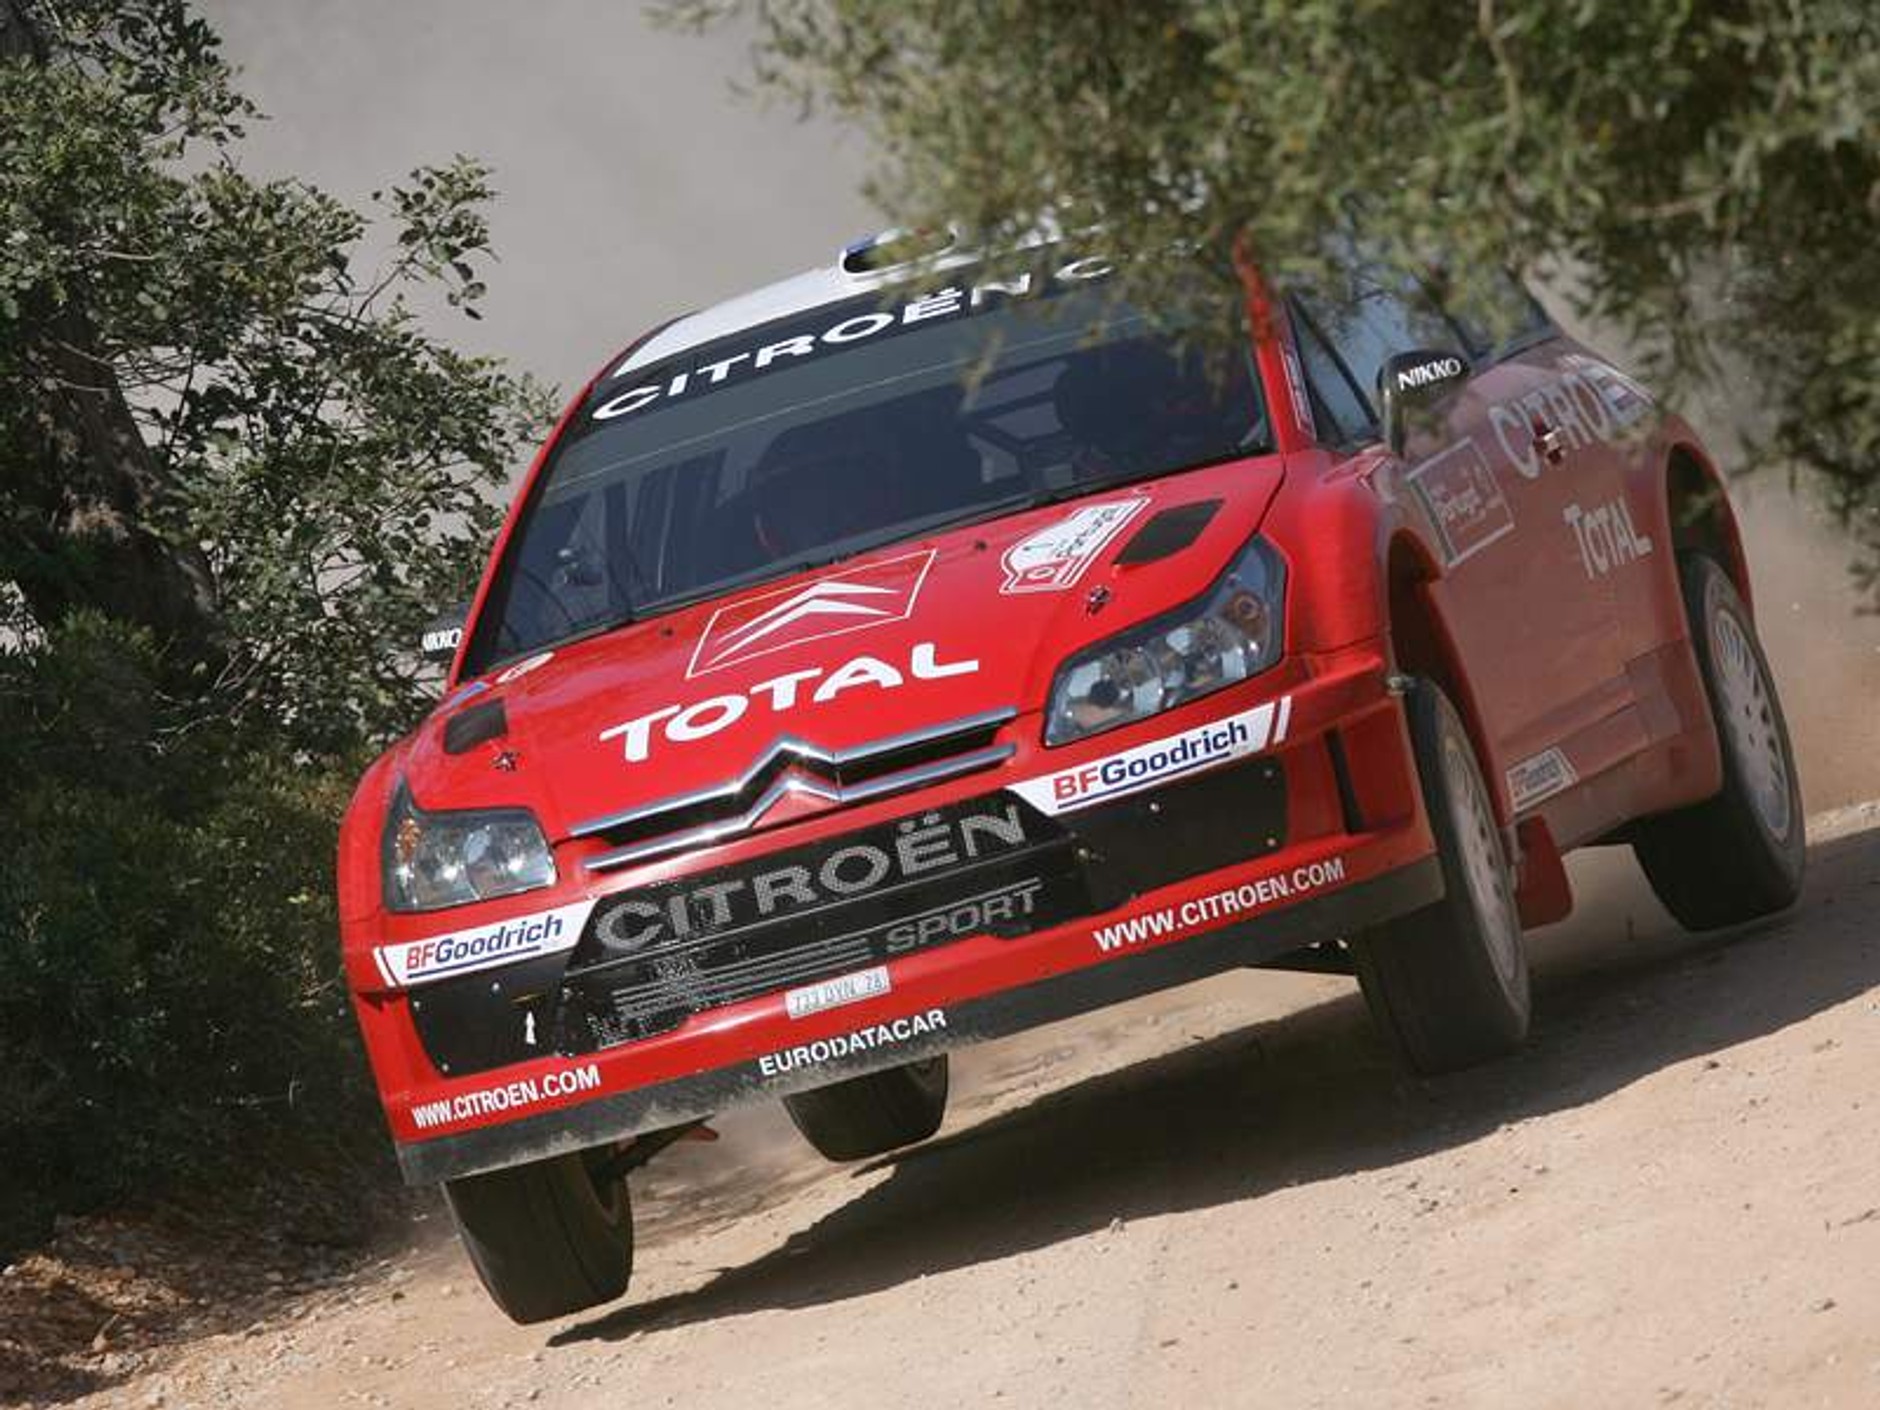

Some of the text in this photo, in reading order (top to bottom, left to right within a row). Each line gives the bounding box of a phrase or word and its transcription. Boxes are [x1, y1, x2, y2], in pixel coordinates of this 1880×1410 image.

[1398, 357, 1461, 391] NIKKO
[1563, 497, 1653, 579] TOTAL
[600, 642, 979, 763] TOTAL
[1053, 721, 1248, 801] BFGoodrich
[595, 805, 1027, 952] CITROËN
[1093, 858, 1345, 951] WWW.CITROEN.COM
[406, 915, 563, 971] BFGoodrich
[886, 884, 1042, 954] SPORT
[758, 1008, 947, 1077] EURODATACAR
[411, 1064, 601, 1130] WWW.CITROEN.COM
